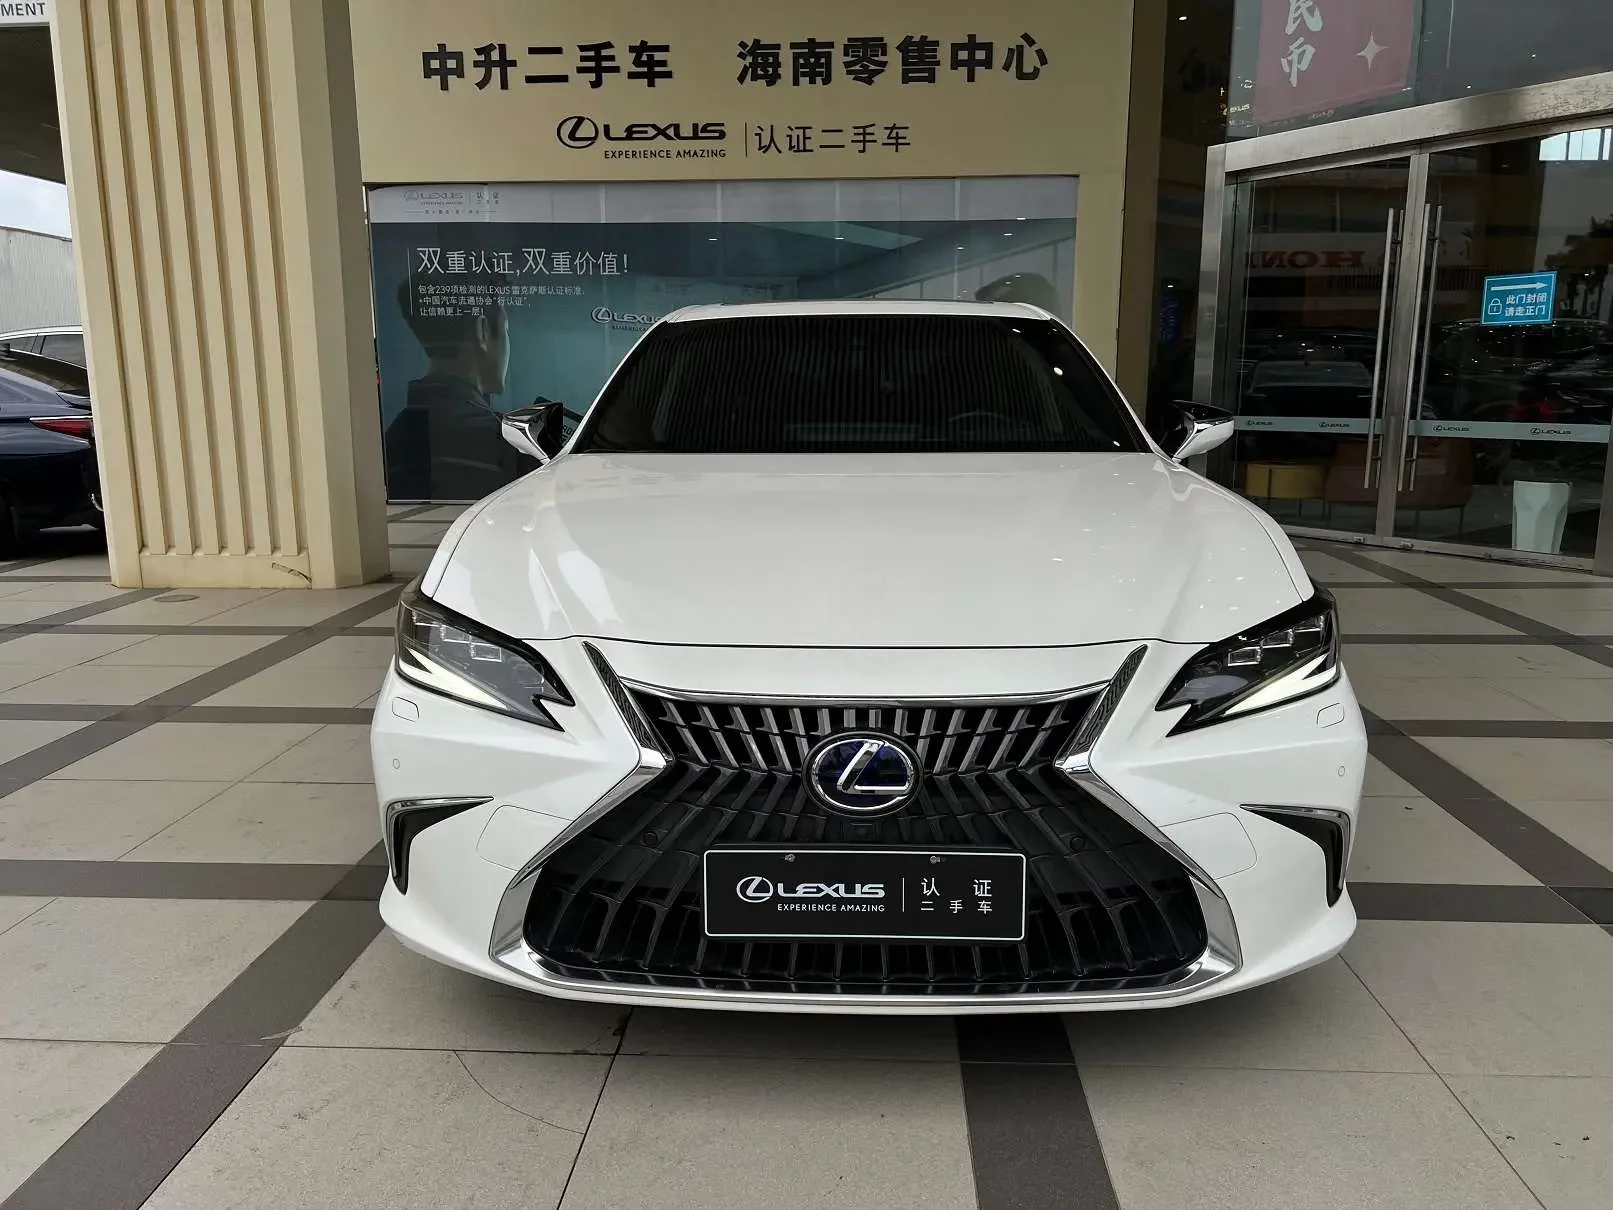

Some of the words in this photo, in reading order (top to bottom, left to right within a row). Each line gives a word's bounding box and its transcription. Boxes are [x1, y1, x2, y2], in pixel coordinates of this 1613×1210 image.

[0, 2, 45, 17] MENT
[421, 40, 673, 91] 中升二手车
[735, 33, 1049, 87] 海南零售中心
[603, 122, 727, 141] LEXUS
[754, 122, 911, 154] 认证二手车
[603, 149, 672, 159] EXPERIENCE
[675, 148, 727, 159] AMAZING
[1505, 293, 1547, 305] 此门封闭
[1504, 305, 1546, 317] 请走正门
[777, 883, 885, 898] LEXUS
[920, 877, 993, 898] 认证
[777, 903, 837, 912] EXPERIENCE
[840, 903, 885, 912] AMAZING
[920, 899, 993, 914] 二手车
